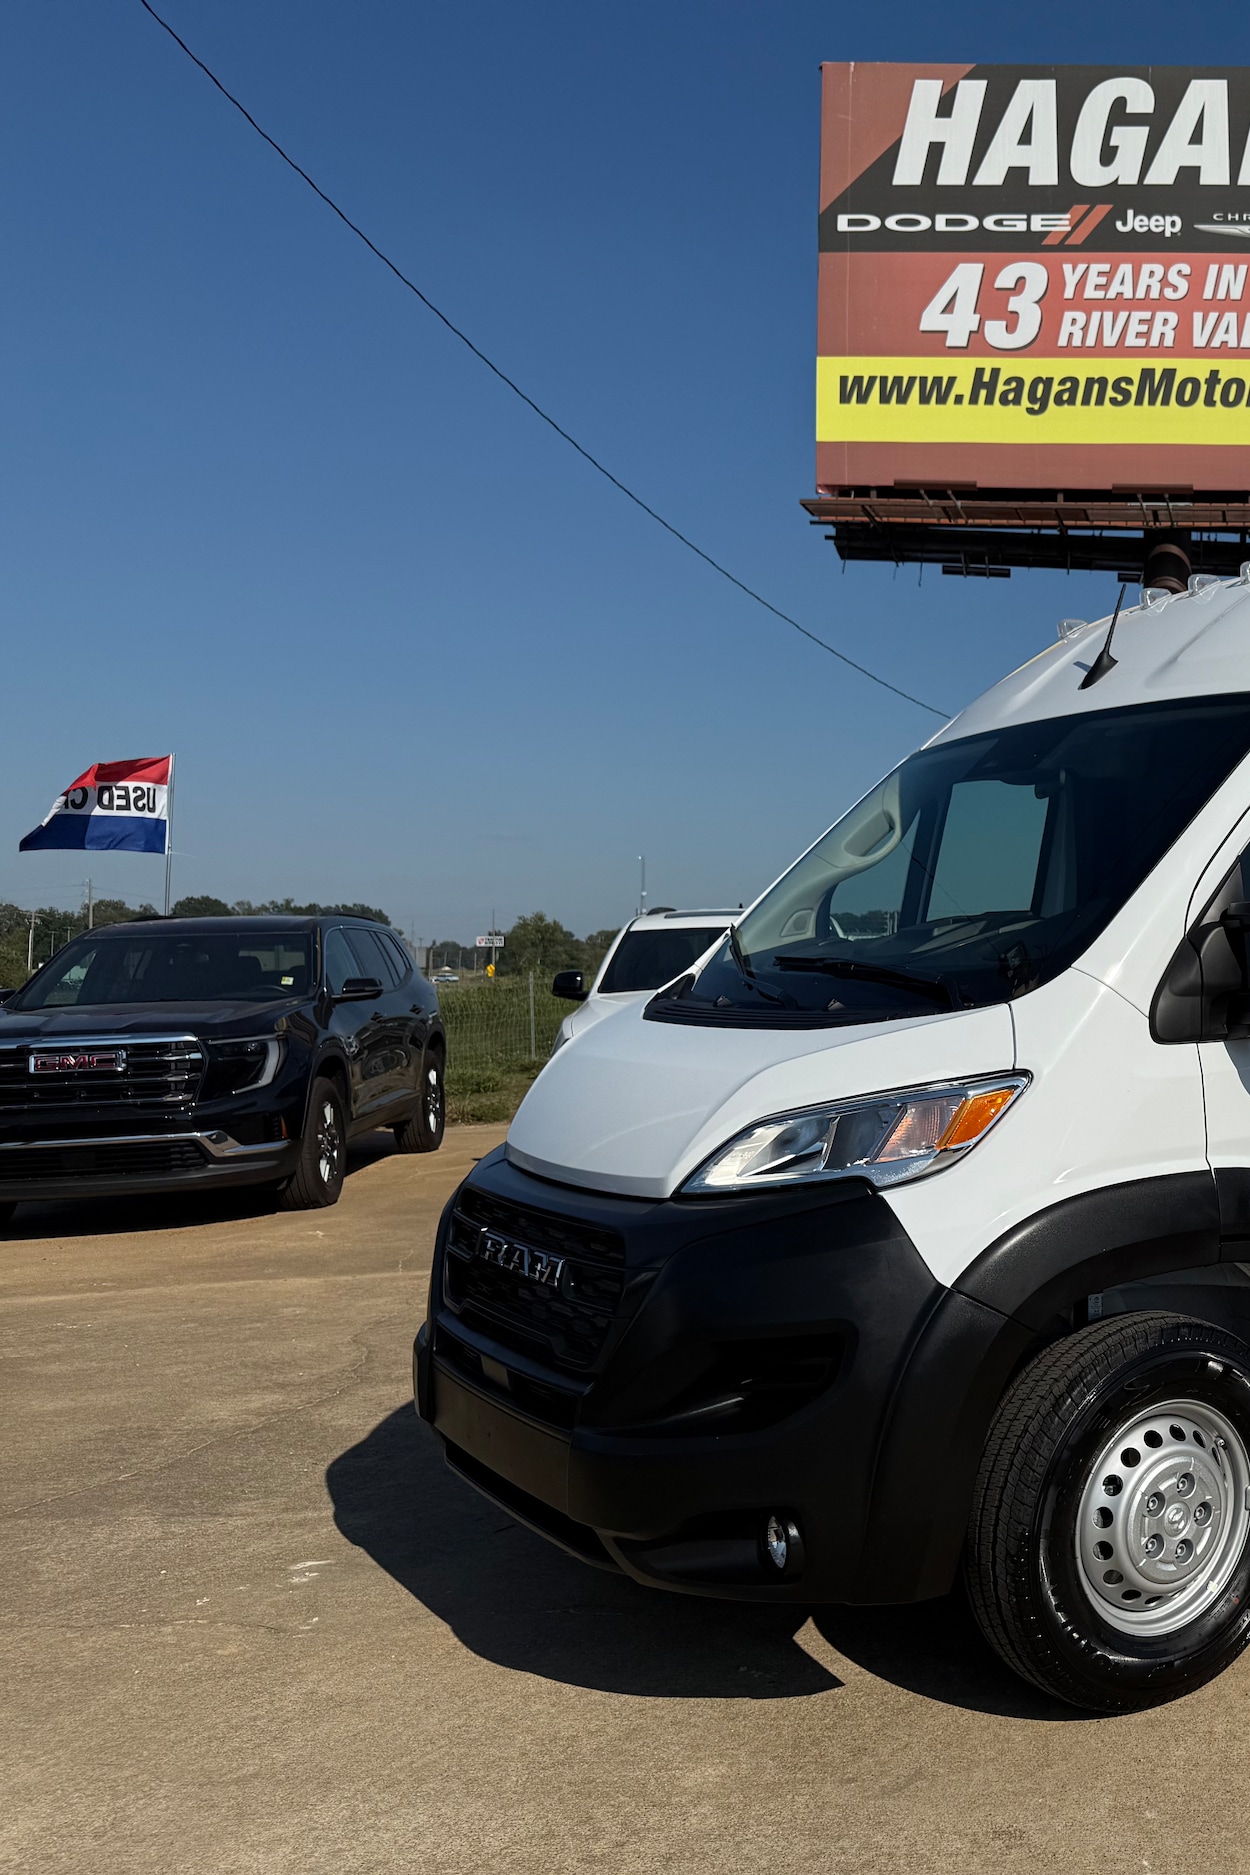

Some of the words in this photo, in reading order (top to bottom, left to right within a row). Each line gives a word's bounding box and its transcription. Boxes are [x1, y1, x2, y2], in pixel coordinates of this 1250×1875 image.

[837, 213, 1072, 232] DODGE
[1115, 209, 1183, 237] Jeep
[1062, 263, 1191, 301] YEARS
[1202, 264, 1248, 301] IN
[919, 262, 1049, 350] 43
[1057, 311, 1178, 348] RIVER
[34, 1053, 117, 1071] GMC
[481, 1231, 566, 1289] RAM
